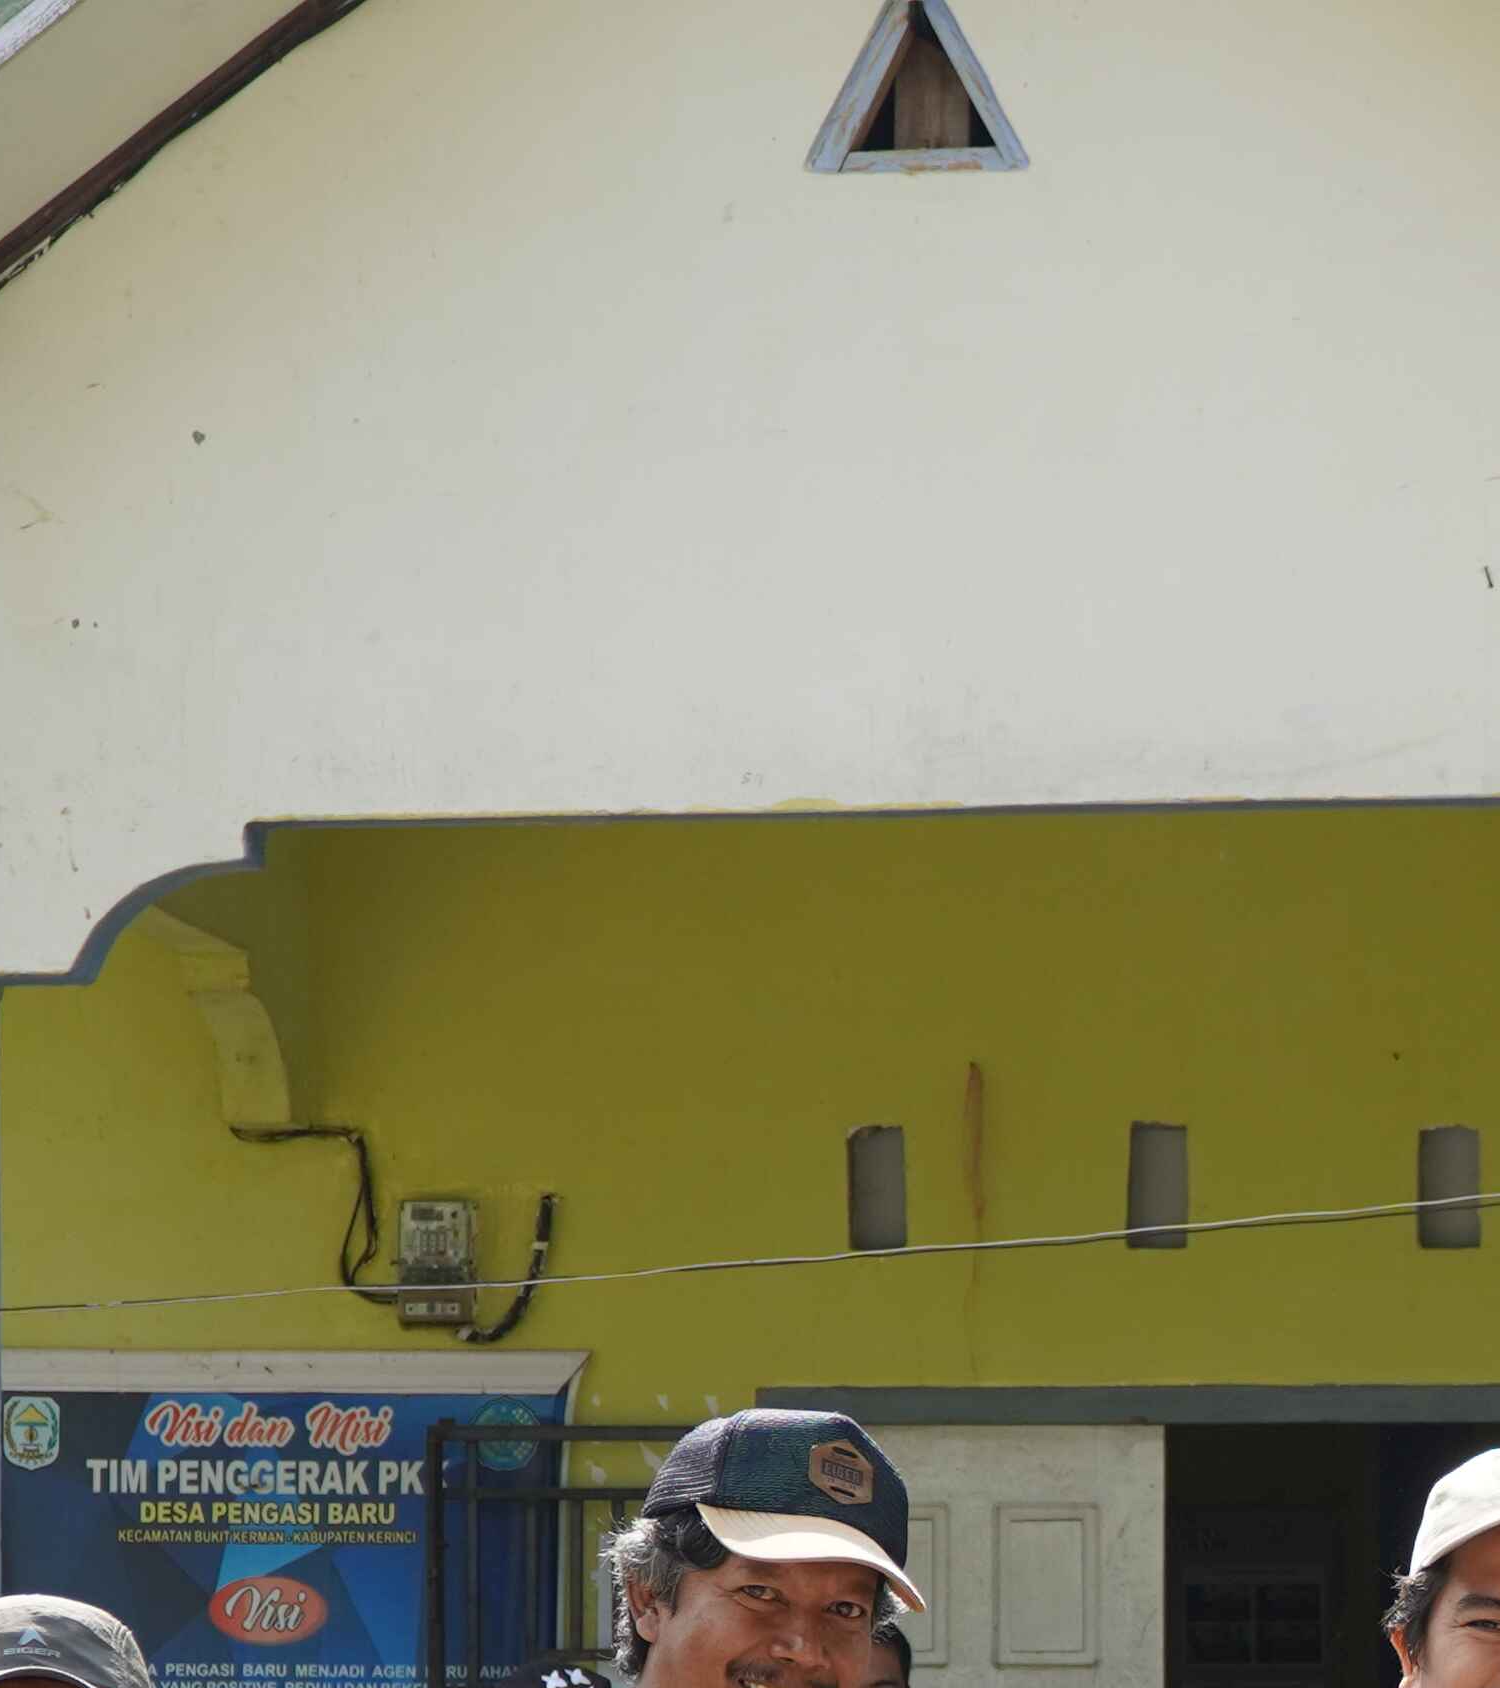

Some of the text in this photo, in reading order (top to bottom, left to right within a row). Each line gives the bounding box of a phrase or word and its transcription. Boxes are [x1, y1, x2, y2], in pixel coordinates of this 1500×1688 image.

[147, 1399, 392, 1455] Visi dan Misi
[86, 1459, 147, 1494] TIM
[157, 1459, 369, 1496] PENGGERAK
[140, 1502, 395, 1525] DESA PENGASI BARU
[117, 1530, 192, 1543] KECAMATAN
[195, 1530, 229, 1543] BUKIT
[234, 1530, 283, 1544] KERMAN
[293, 1531, 365, 1544] KABUPATEN
[367, 1531, 417, 1544] KERINCI
[225, 1585, 307, 1632] Visi
[165, 1663, 234, 1677] PENGASI
[242, 1664, 287, 1677] BARU
[295, 1664, 364, 1678] MENJADI
[371, 1665, 416, 1679] AGEN
